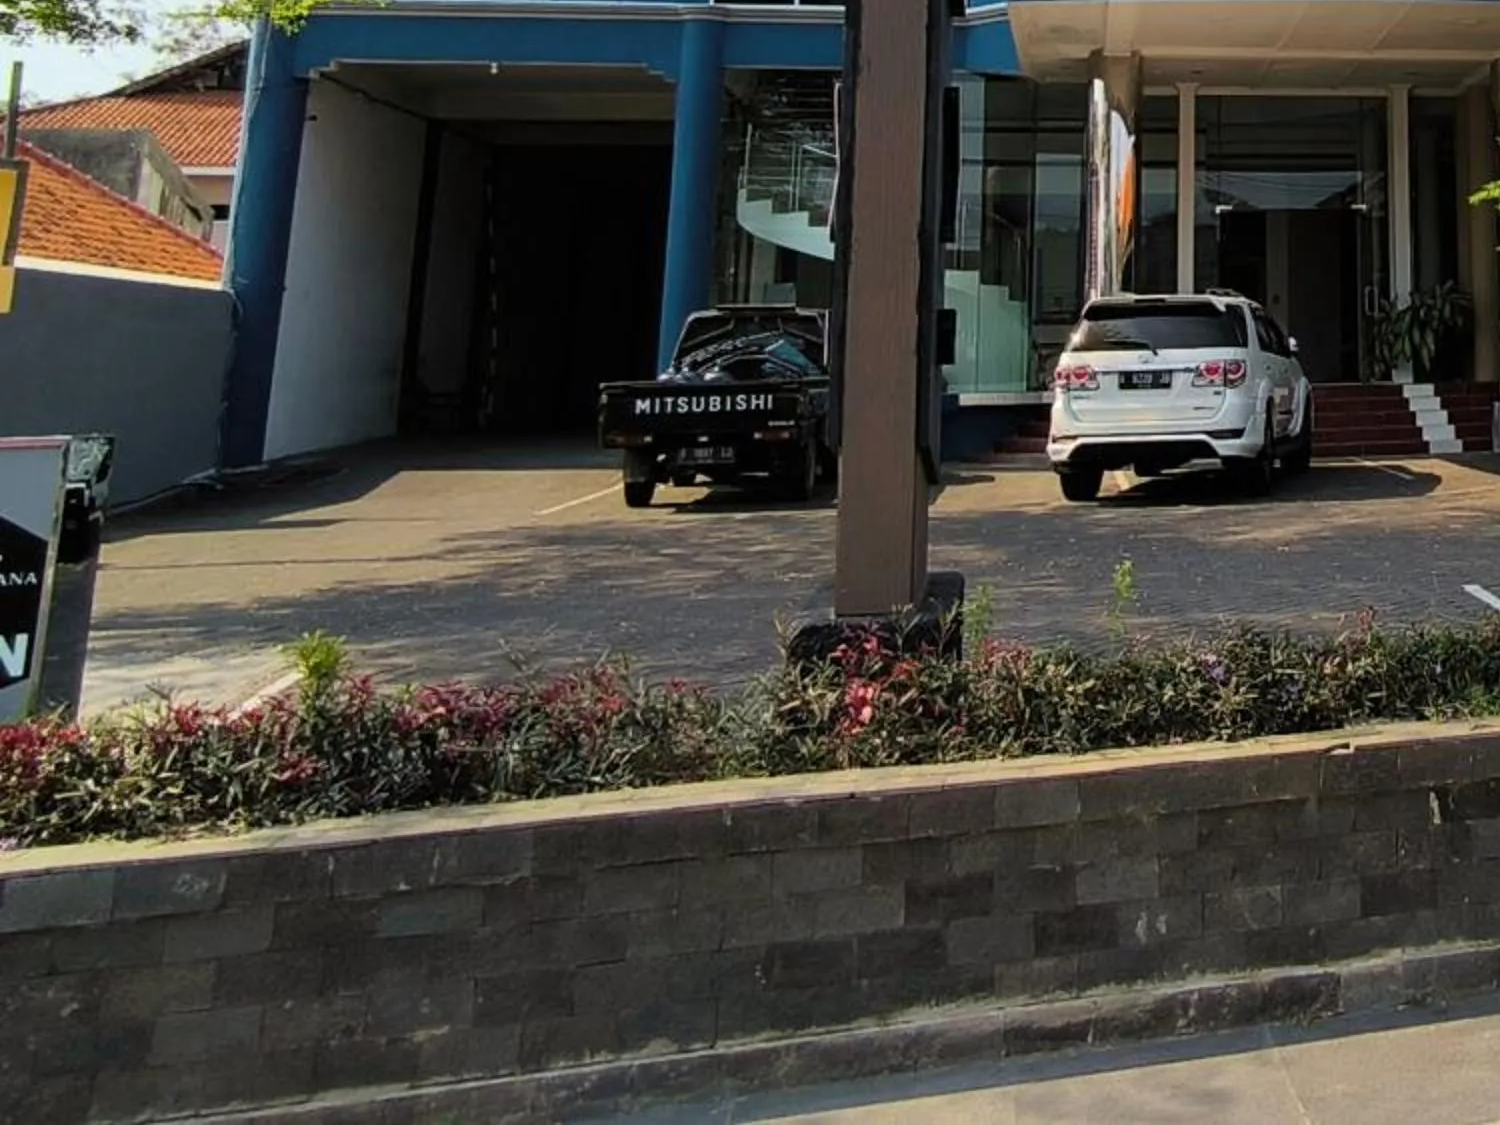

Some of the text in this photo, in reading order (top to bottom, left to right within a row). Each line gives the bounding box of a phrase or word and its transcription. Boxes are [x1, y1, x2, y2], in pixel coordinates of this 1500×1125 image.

[635, 394, 774, 414] MITSUBISHI
[0, 570, 38, 587] ANA
[0, 632, 29, 678] N
